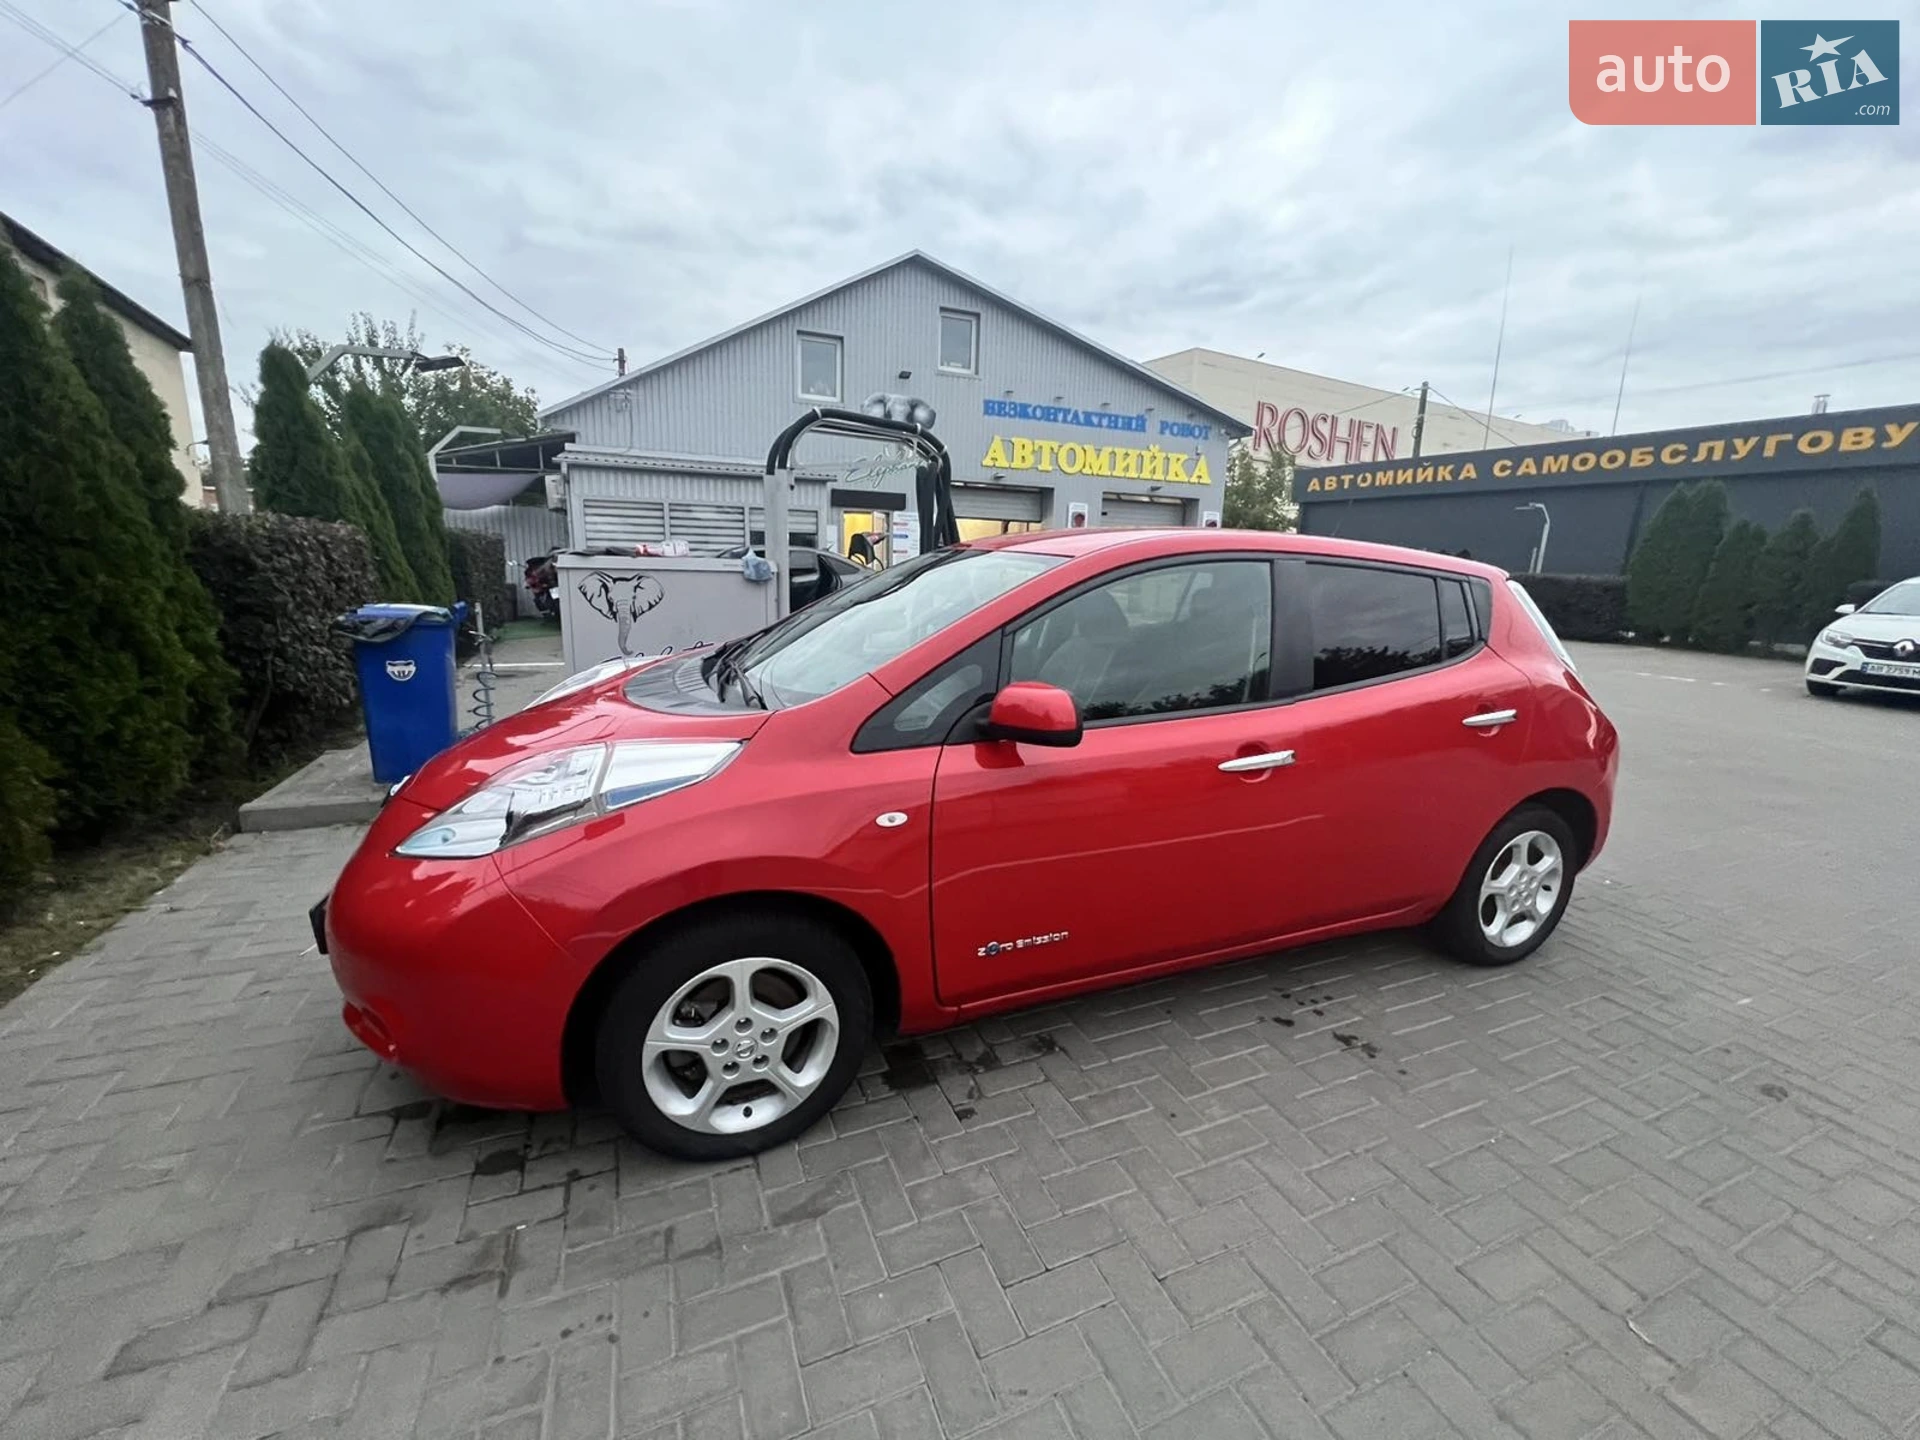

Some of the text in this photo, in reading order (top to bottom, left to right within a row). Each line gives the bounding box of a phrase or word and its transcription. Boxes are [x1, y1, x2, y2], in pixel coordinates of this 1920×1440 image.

[1159, 420, 1212, 441] РОБОТ
[1253, 400, 1399, 464] ROSHEN
[1306, 421, 1919, 493] АВТОМИЙКА САМООБСЛУГОВУ
[982, 435, 1212, 485] АВТОМИЙКА
